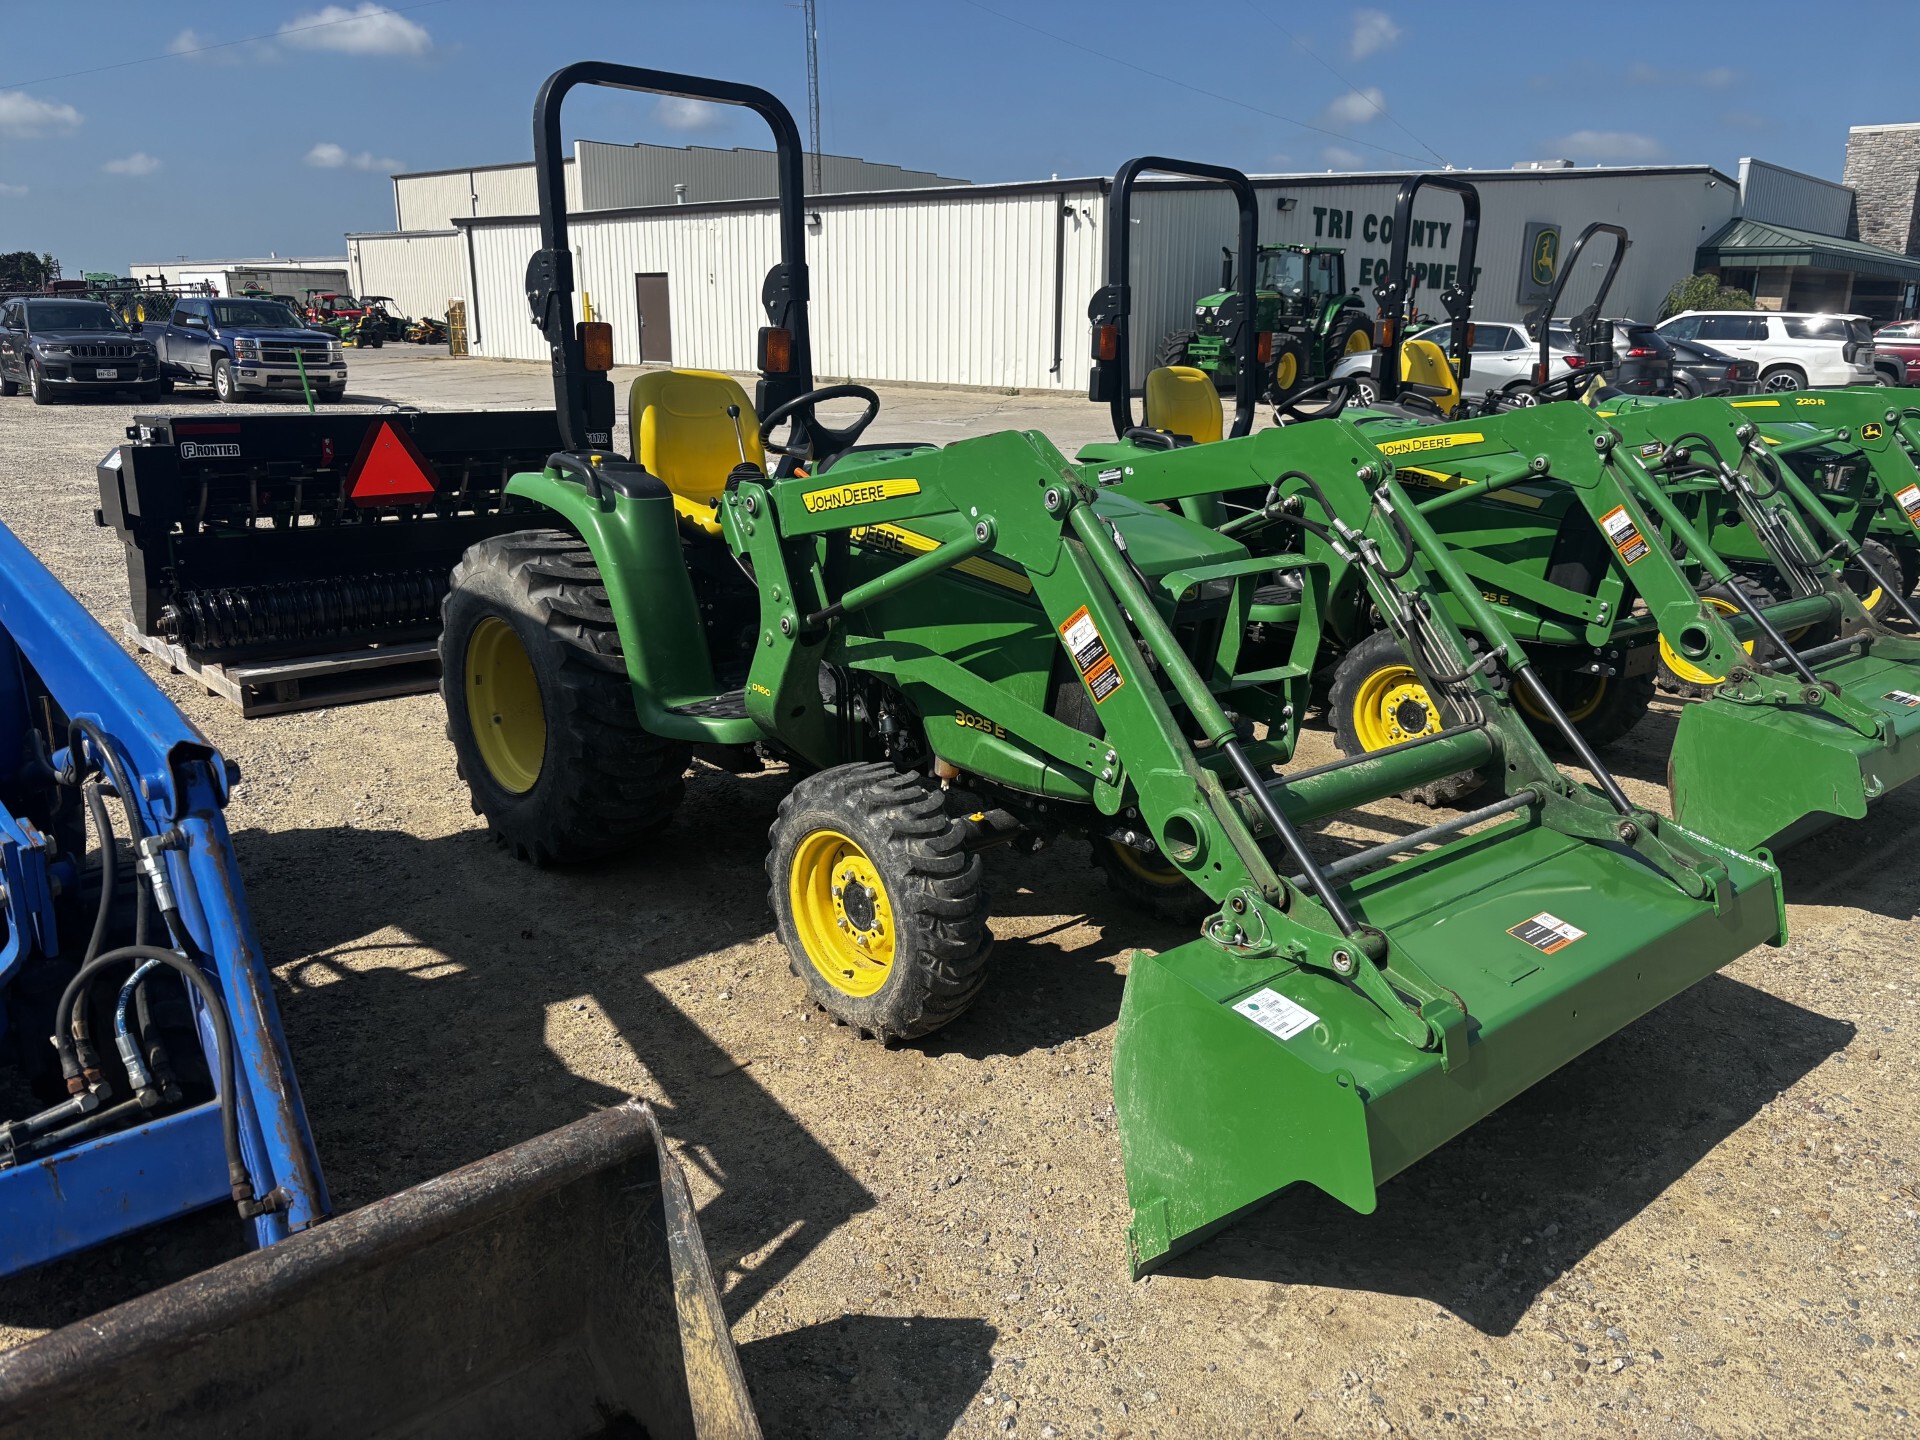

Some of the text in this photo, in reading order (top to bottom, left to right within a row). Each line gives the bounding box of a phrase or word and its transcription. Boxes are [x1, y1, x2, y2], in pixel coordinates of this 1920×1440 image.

[1313, 206, 1452, 249] TRI CONTY
[1796, 398, 1816, 406] 220
[181, 441, 241, 459] FRONTIER
[1382, 437, 1452, 455] JOHN DEERE
[1396, 469, 1430, 487] EERE
[810, 484, 886, 511] JOHN DEERE
[1482, 591, 1510, 605] 25 E
[752, 683, 771, 697] D160
[955, 709, 1006, 739] 3025 E
